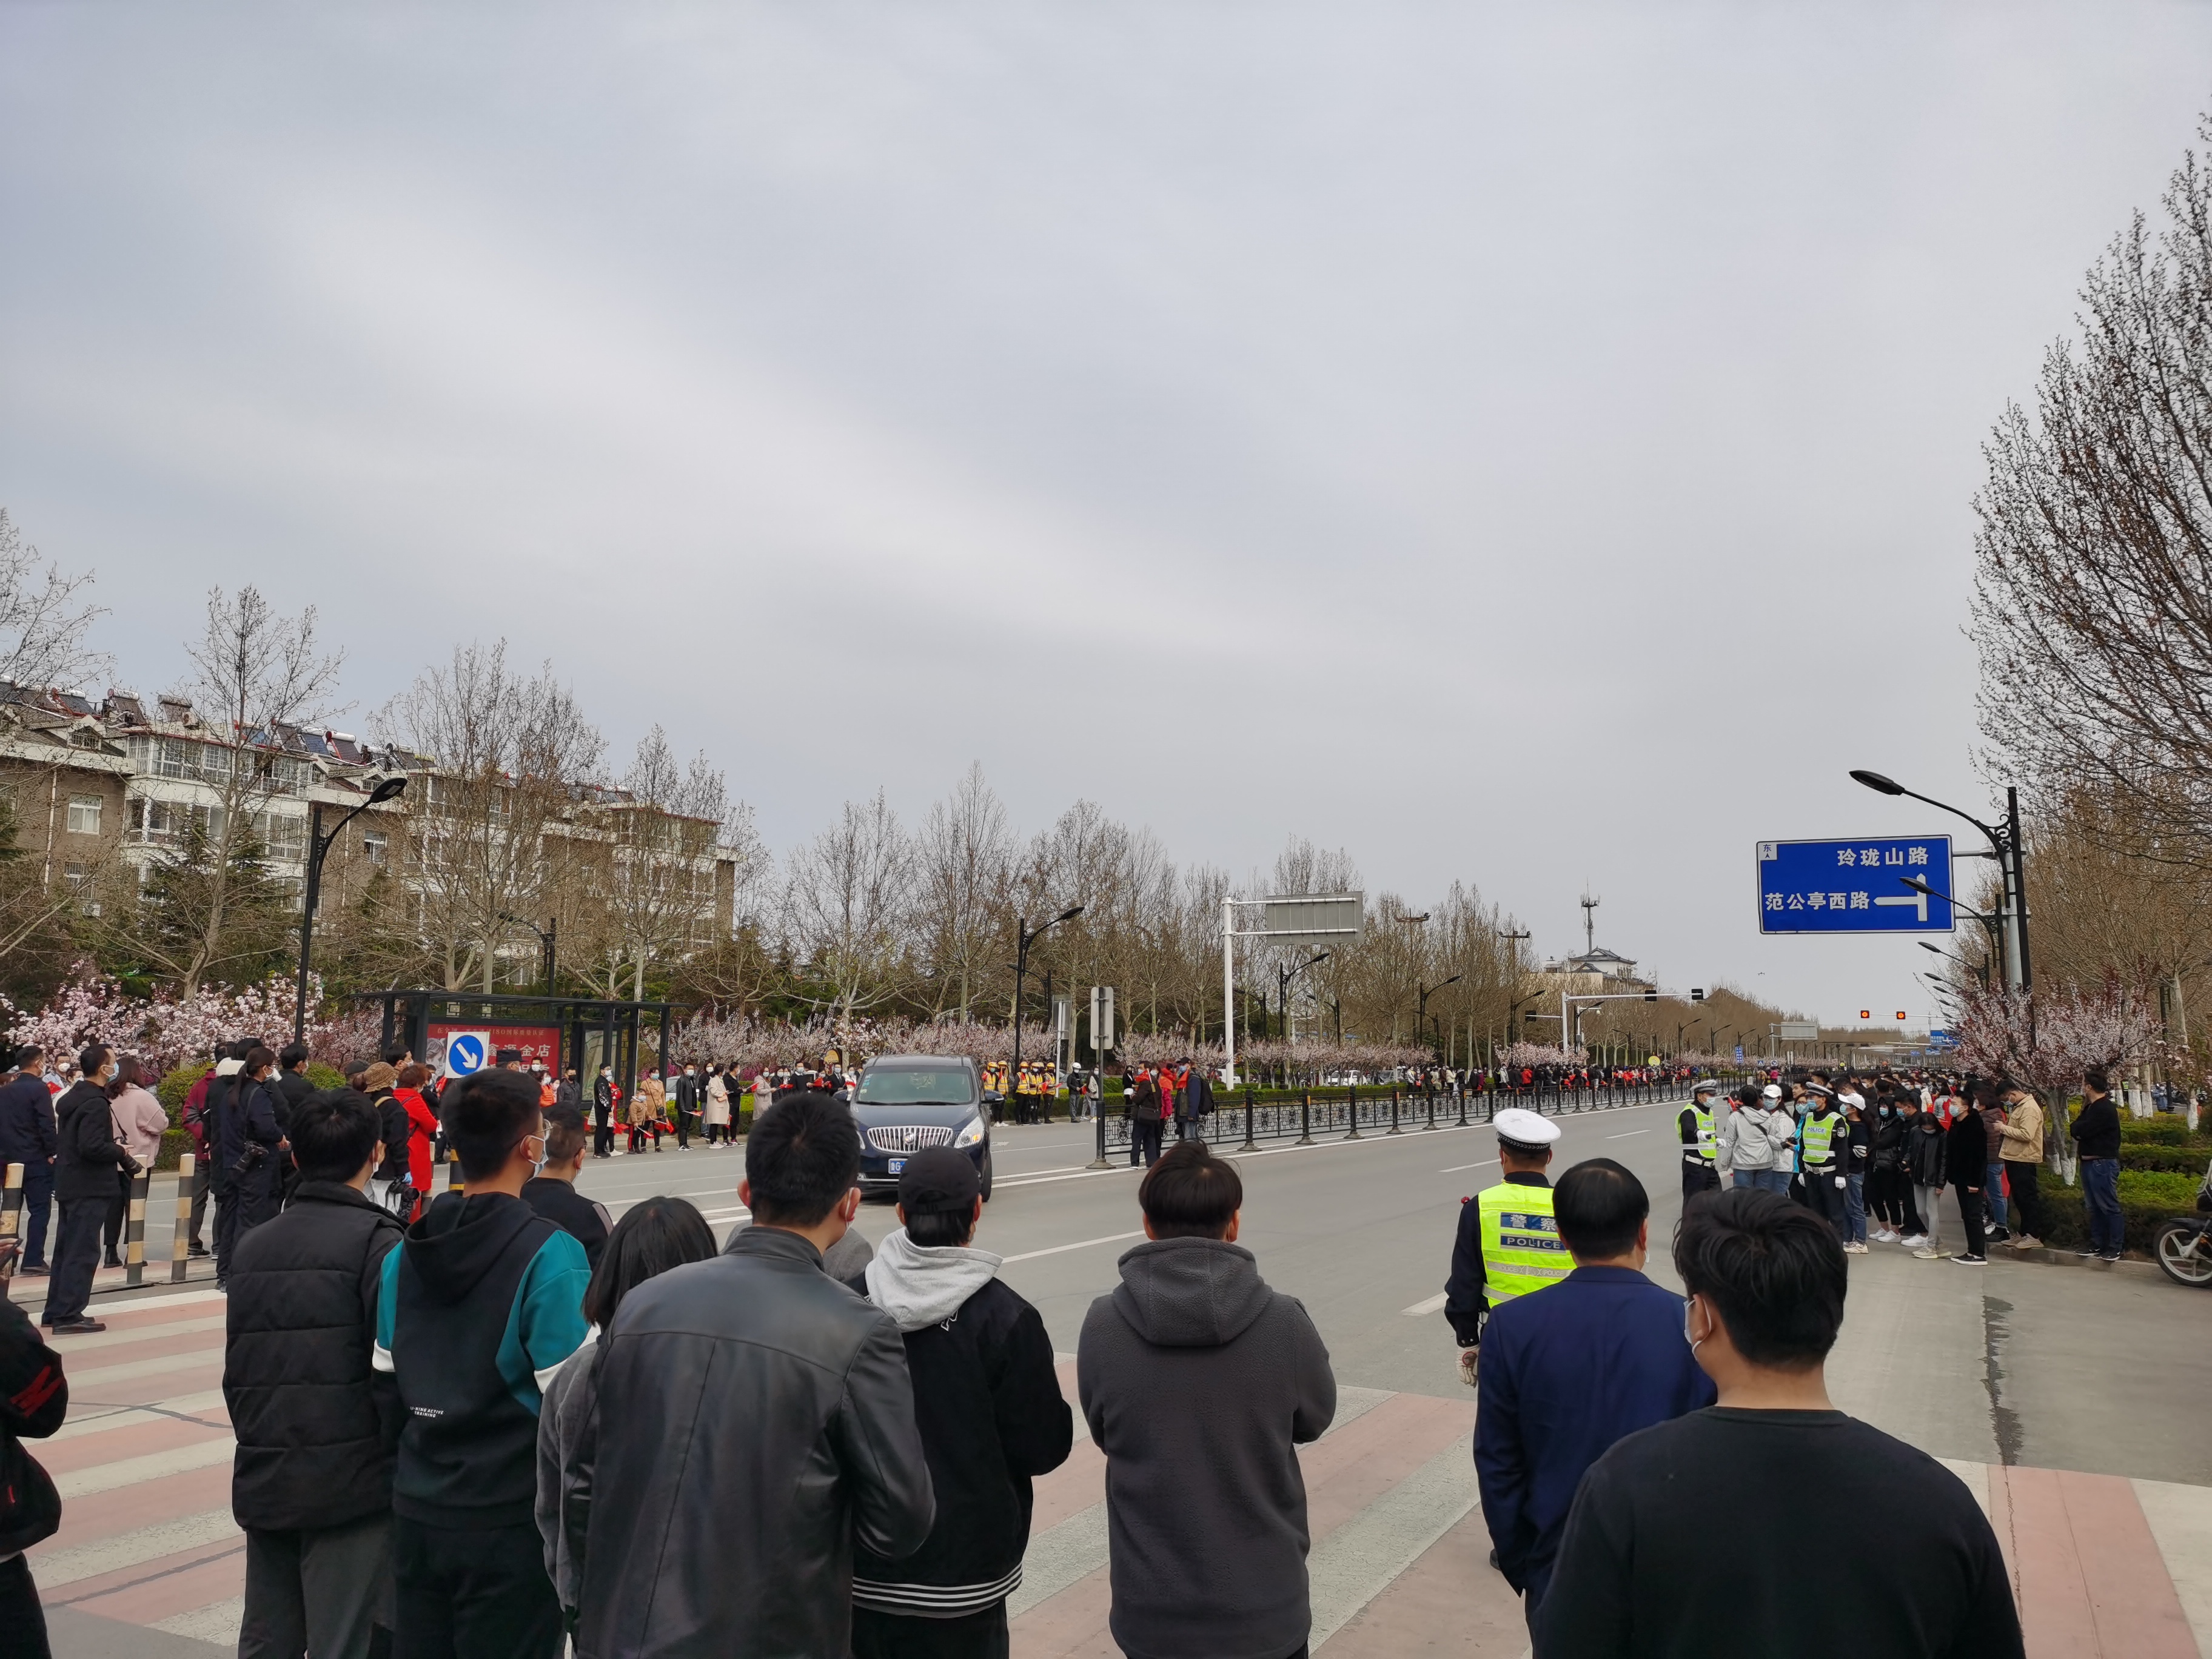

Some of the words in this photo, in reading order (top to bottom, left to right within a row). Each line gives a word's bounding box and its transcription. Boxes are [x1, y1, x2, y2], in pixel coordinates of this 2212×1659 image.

[1837, 847, 1929, 866] 玲珑山路
[1765, 891, 1870, 911] 范公亭西路
[1510, 1215, 1556, 1231] 警察
[1507, 1238, 1561, 1249] POLICE
